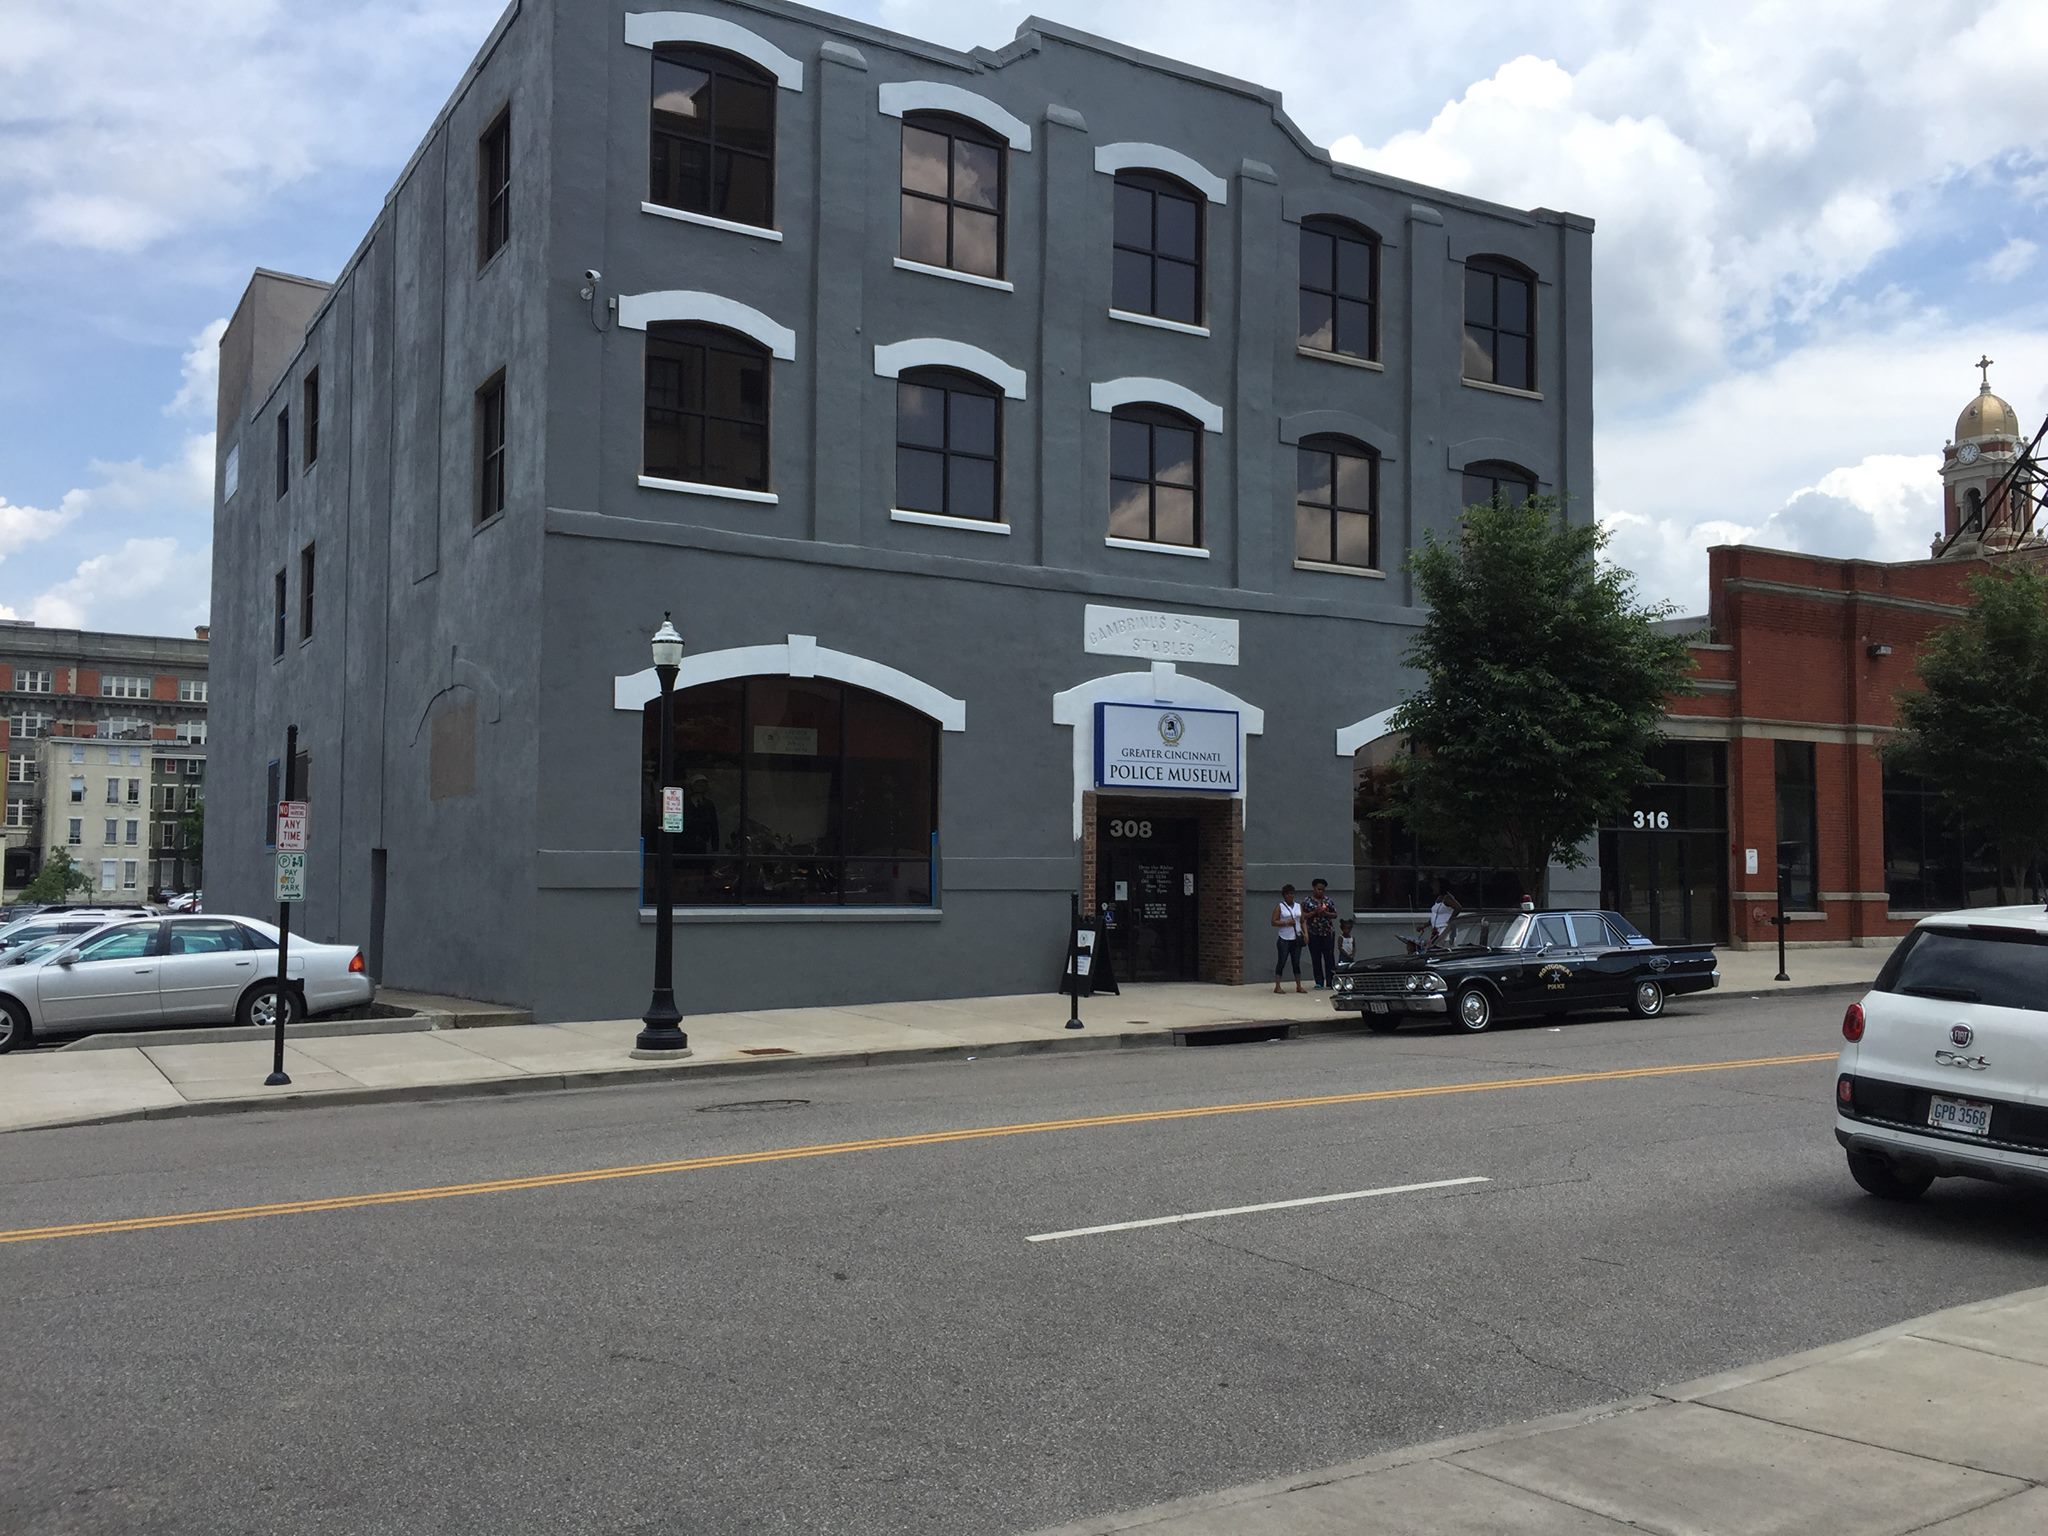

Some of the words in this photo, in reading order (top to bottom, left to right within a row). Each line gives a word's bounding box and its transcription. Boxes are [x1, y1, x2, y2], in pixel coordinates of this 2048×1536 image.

[1089, 615, 1166, 645] GAMBRINUS
[1121, 748, 1162, 759] GREATER
[1164, 750, 1221, 762] CINCINNATI
[1110, 764, 1163, 781] POLICE
[1168, 767, 1232, 784] MUSEUM
[280, 804, 288, 815] NO
[284, 820, 300, 829] ANY
[1633, 810, 1669, 829] 316
[283, 831, 301, 841] TIME
[1110, 819, 1152, 838] 308
[1954, 1030, 1968, 1042] FIAT
[1934, 1104, 1956, 1121] GPB
[1958, 1107, 1987, 1127] 3568
